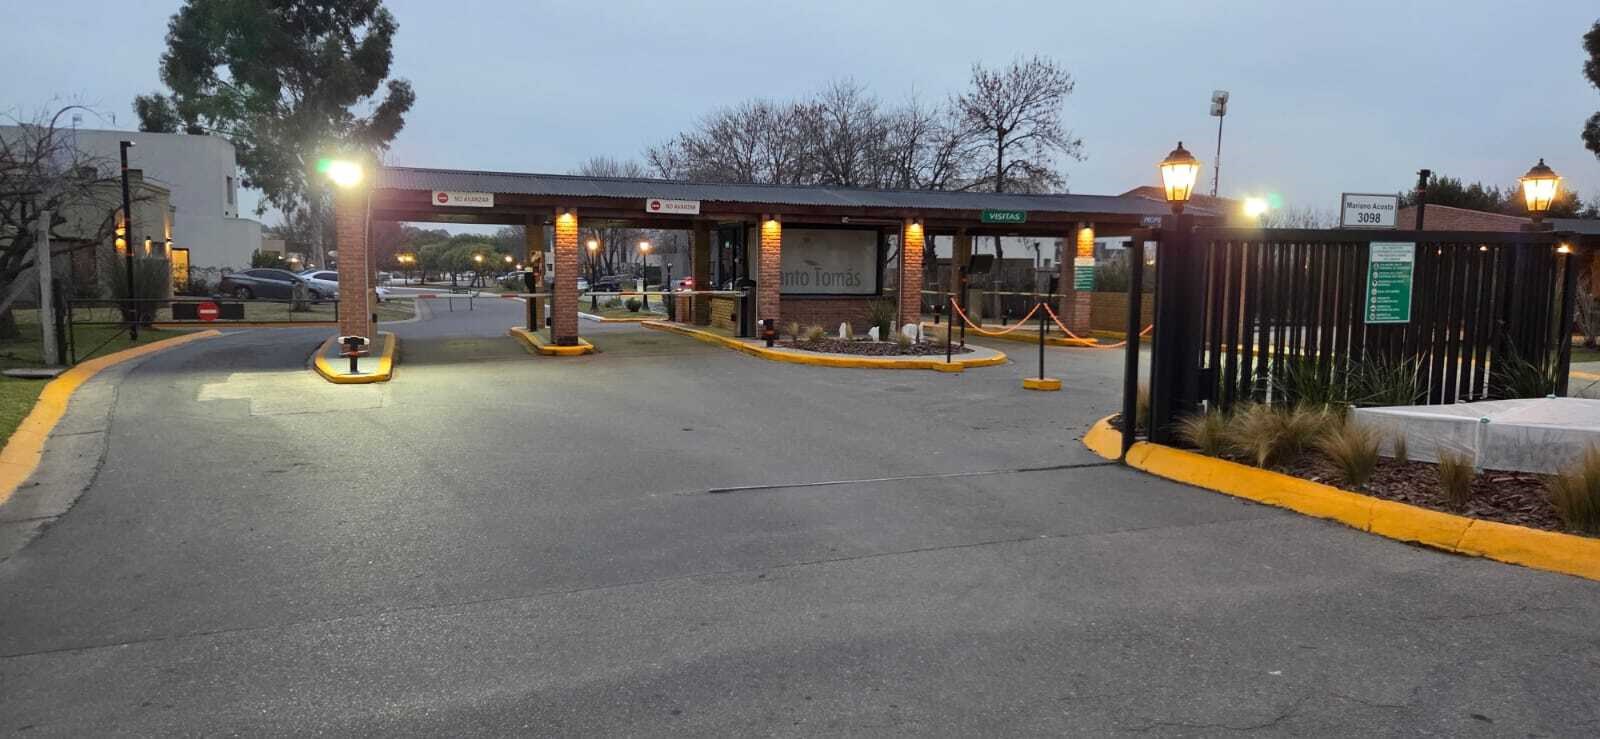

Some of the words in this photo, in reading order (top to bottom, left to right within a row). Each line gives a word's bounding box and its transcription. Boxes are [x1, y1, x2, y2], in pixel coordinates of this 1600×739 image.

[989, 212, 1020, 220] VISITAS
[1357, 212, 1381, 224] 3098
[815, 266, 862, 287] Tomás
